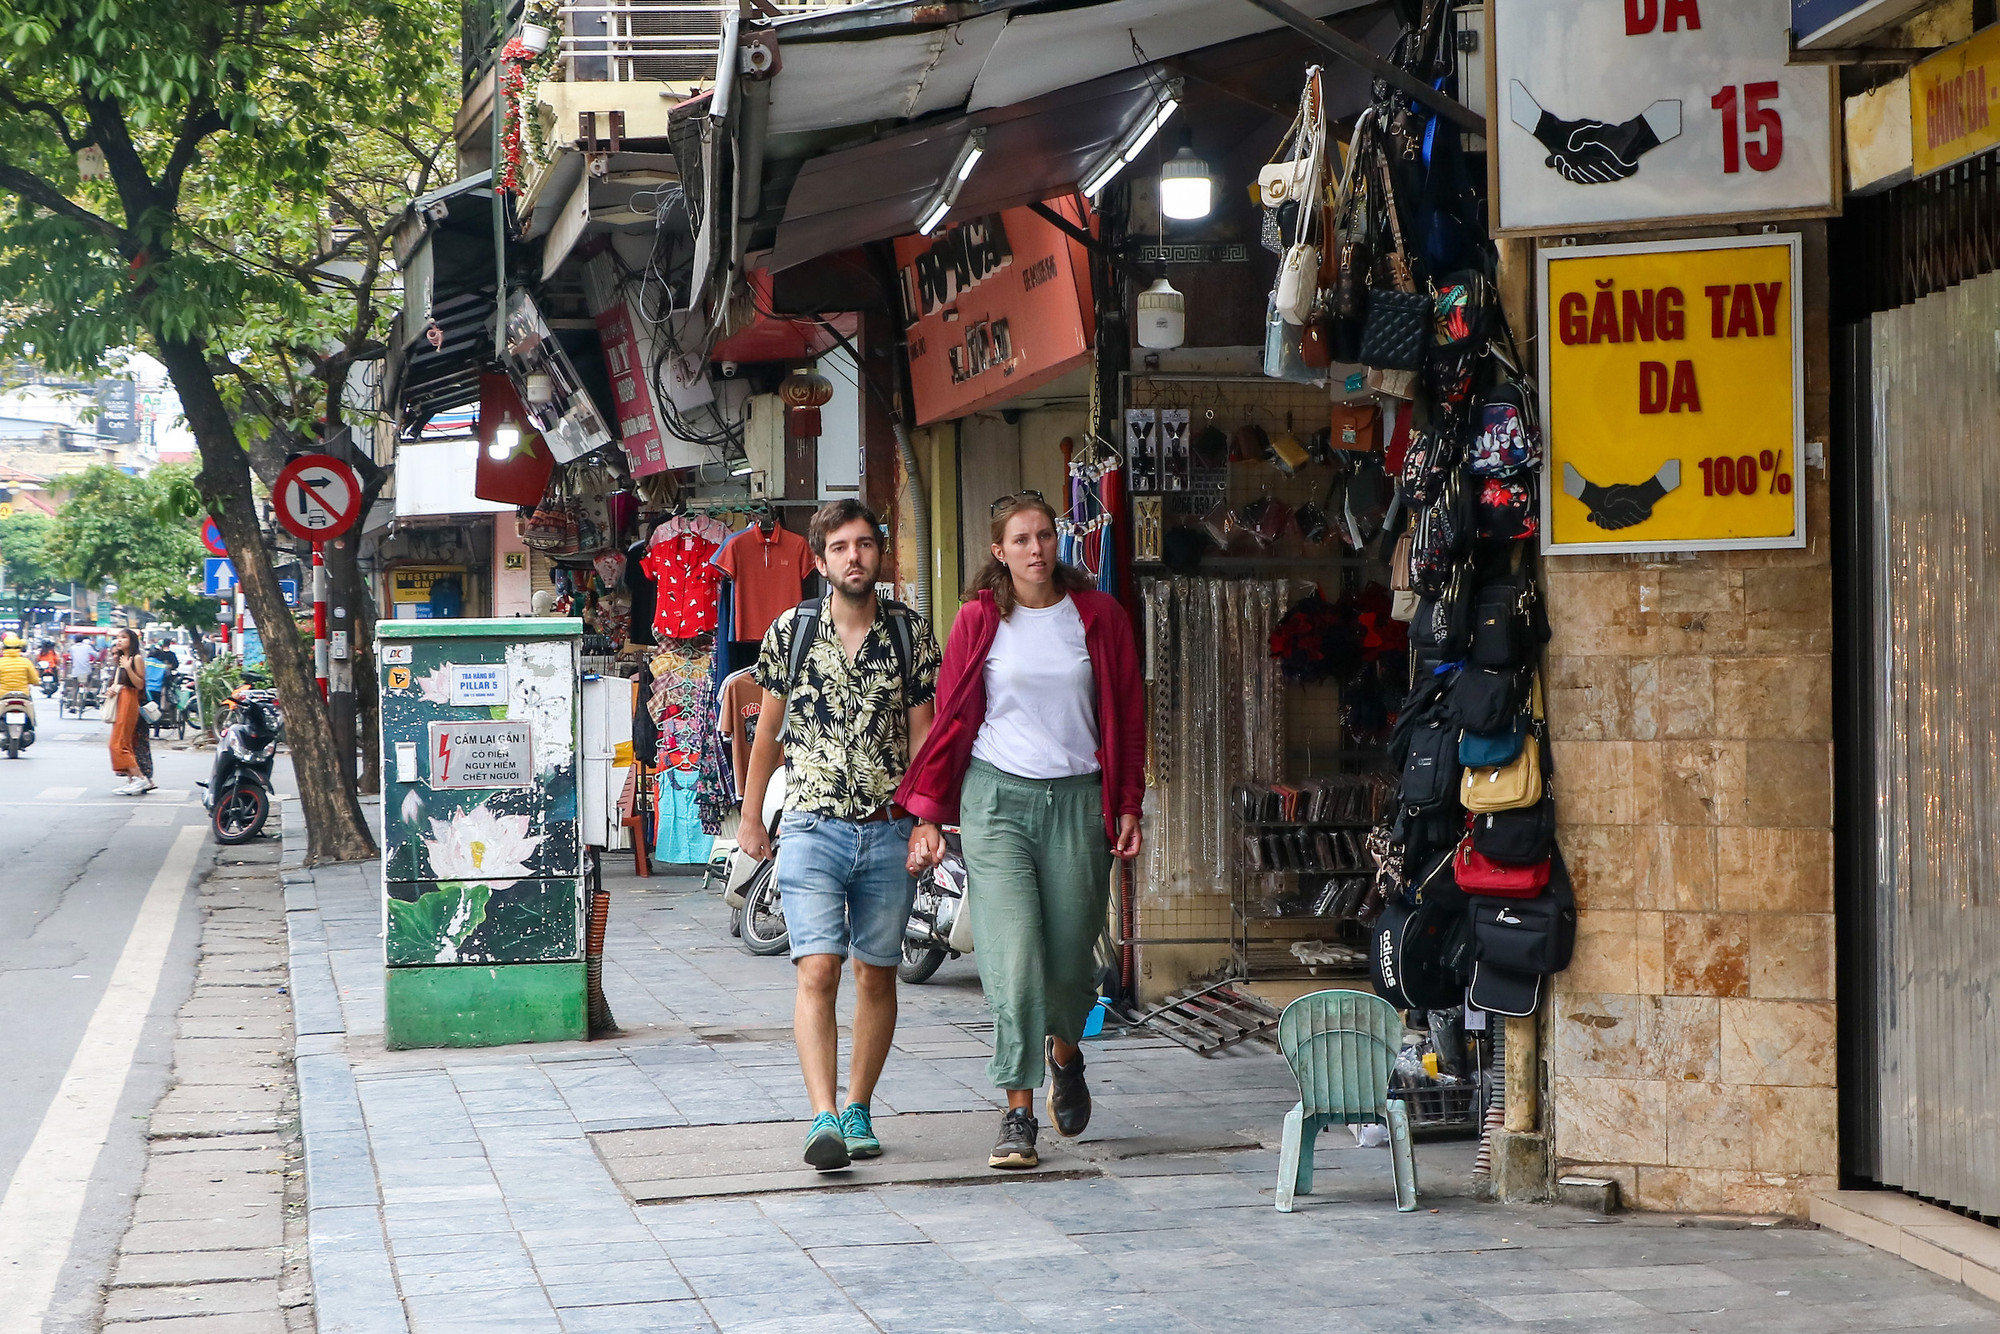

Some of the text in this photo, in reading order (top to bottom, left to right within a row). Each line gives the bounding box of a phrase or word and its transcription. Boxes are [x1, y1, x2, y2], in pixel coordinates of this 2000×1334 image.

[1966, 65, 1990, 134] DA
[1711, 80, 1783, 174] 15
[1558, 279, 1783, 346] GĂNG TAY
[1639, 360, 1702, 415] DA
[104, 411, 129, 420] Music
[1698, 449, 1792, 497] 100%
[460, 681, 498, 690] PILLAR 5
[455, 732, 477, 744] CẤM
[480, 735, 495, 746] LẠI
[463, 771, 487, 781] CHẾT
[1383, 929, 1397, 988] adidas
